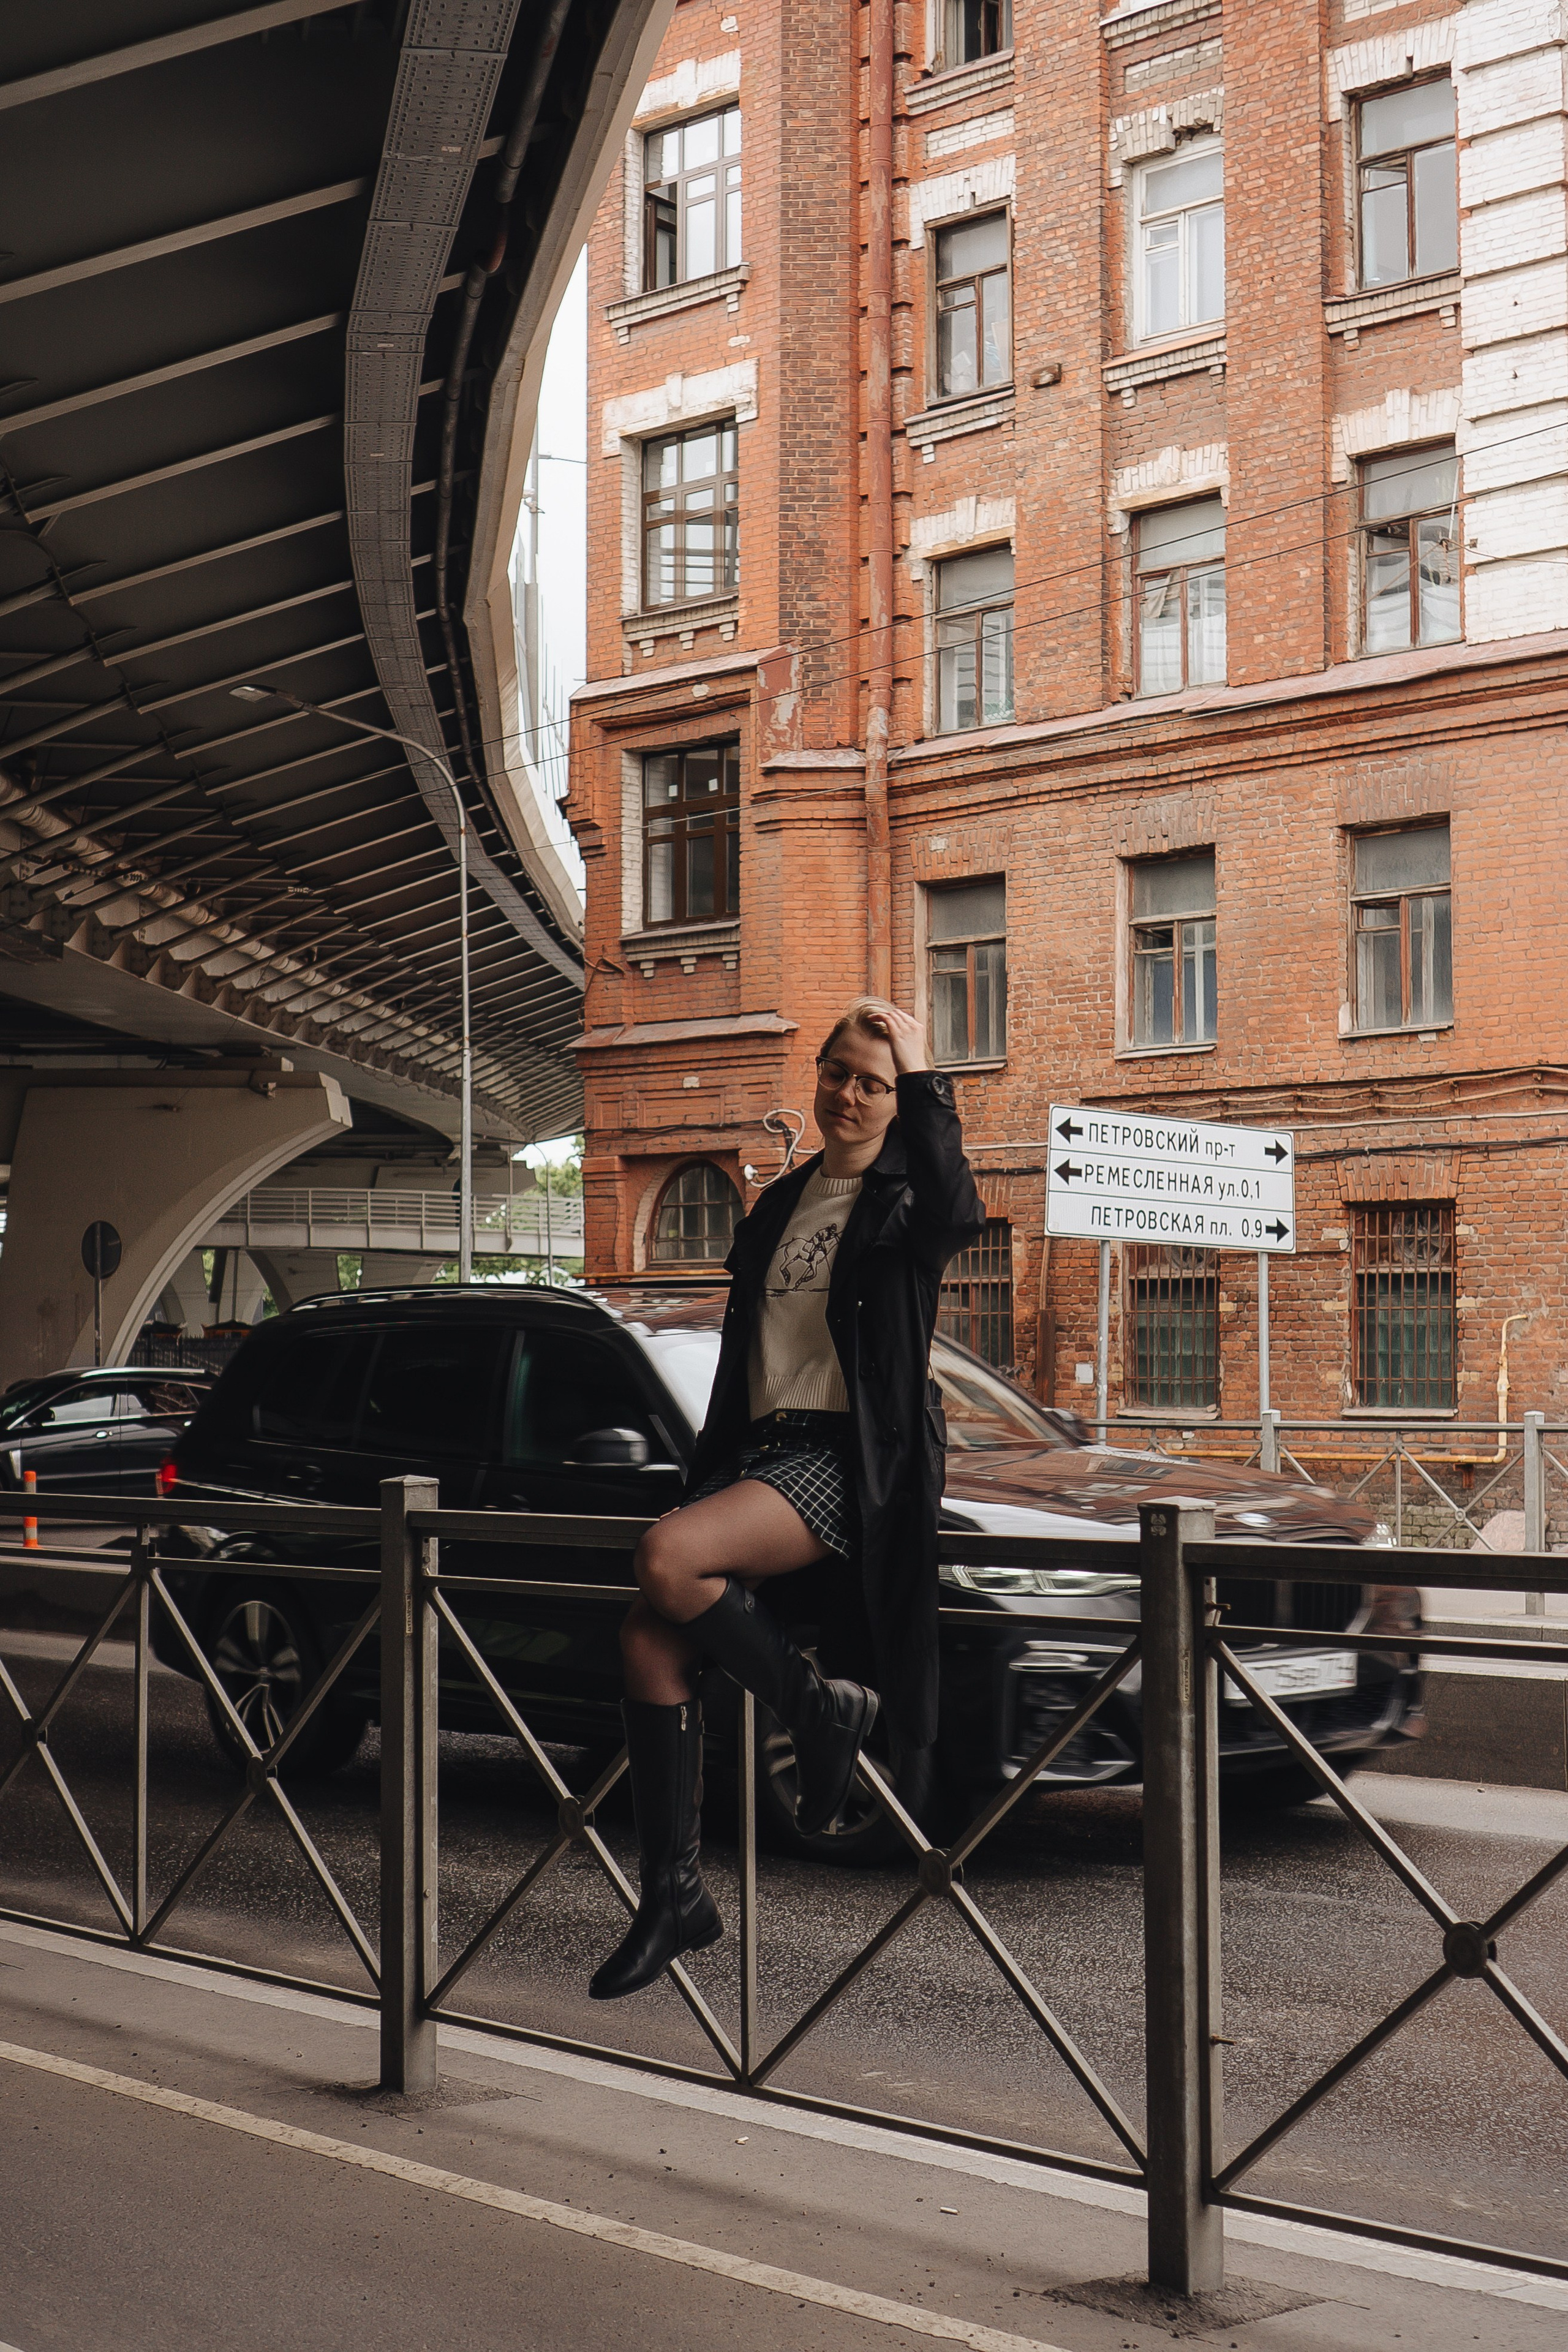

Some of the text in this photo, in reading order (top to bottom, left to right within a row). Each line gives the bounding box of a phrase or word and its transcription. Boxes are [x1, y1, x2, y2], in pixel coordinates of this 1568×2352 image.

[1089, 1123, 1236, 1161] ПЕТРОВСКИЙ пр-т
[1084, 1164, 1213, 1195] РЕМЕСЛЕННАЯ
[1091, 1205, 1263, 1240] ПЕТРОВСКАЯ пл. 0,9
